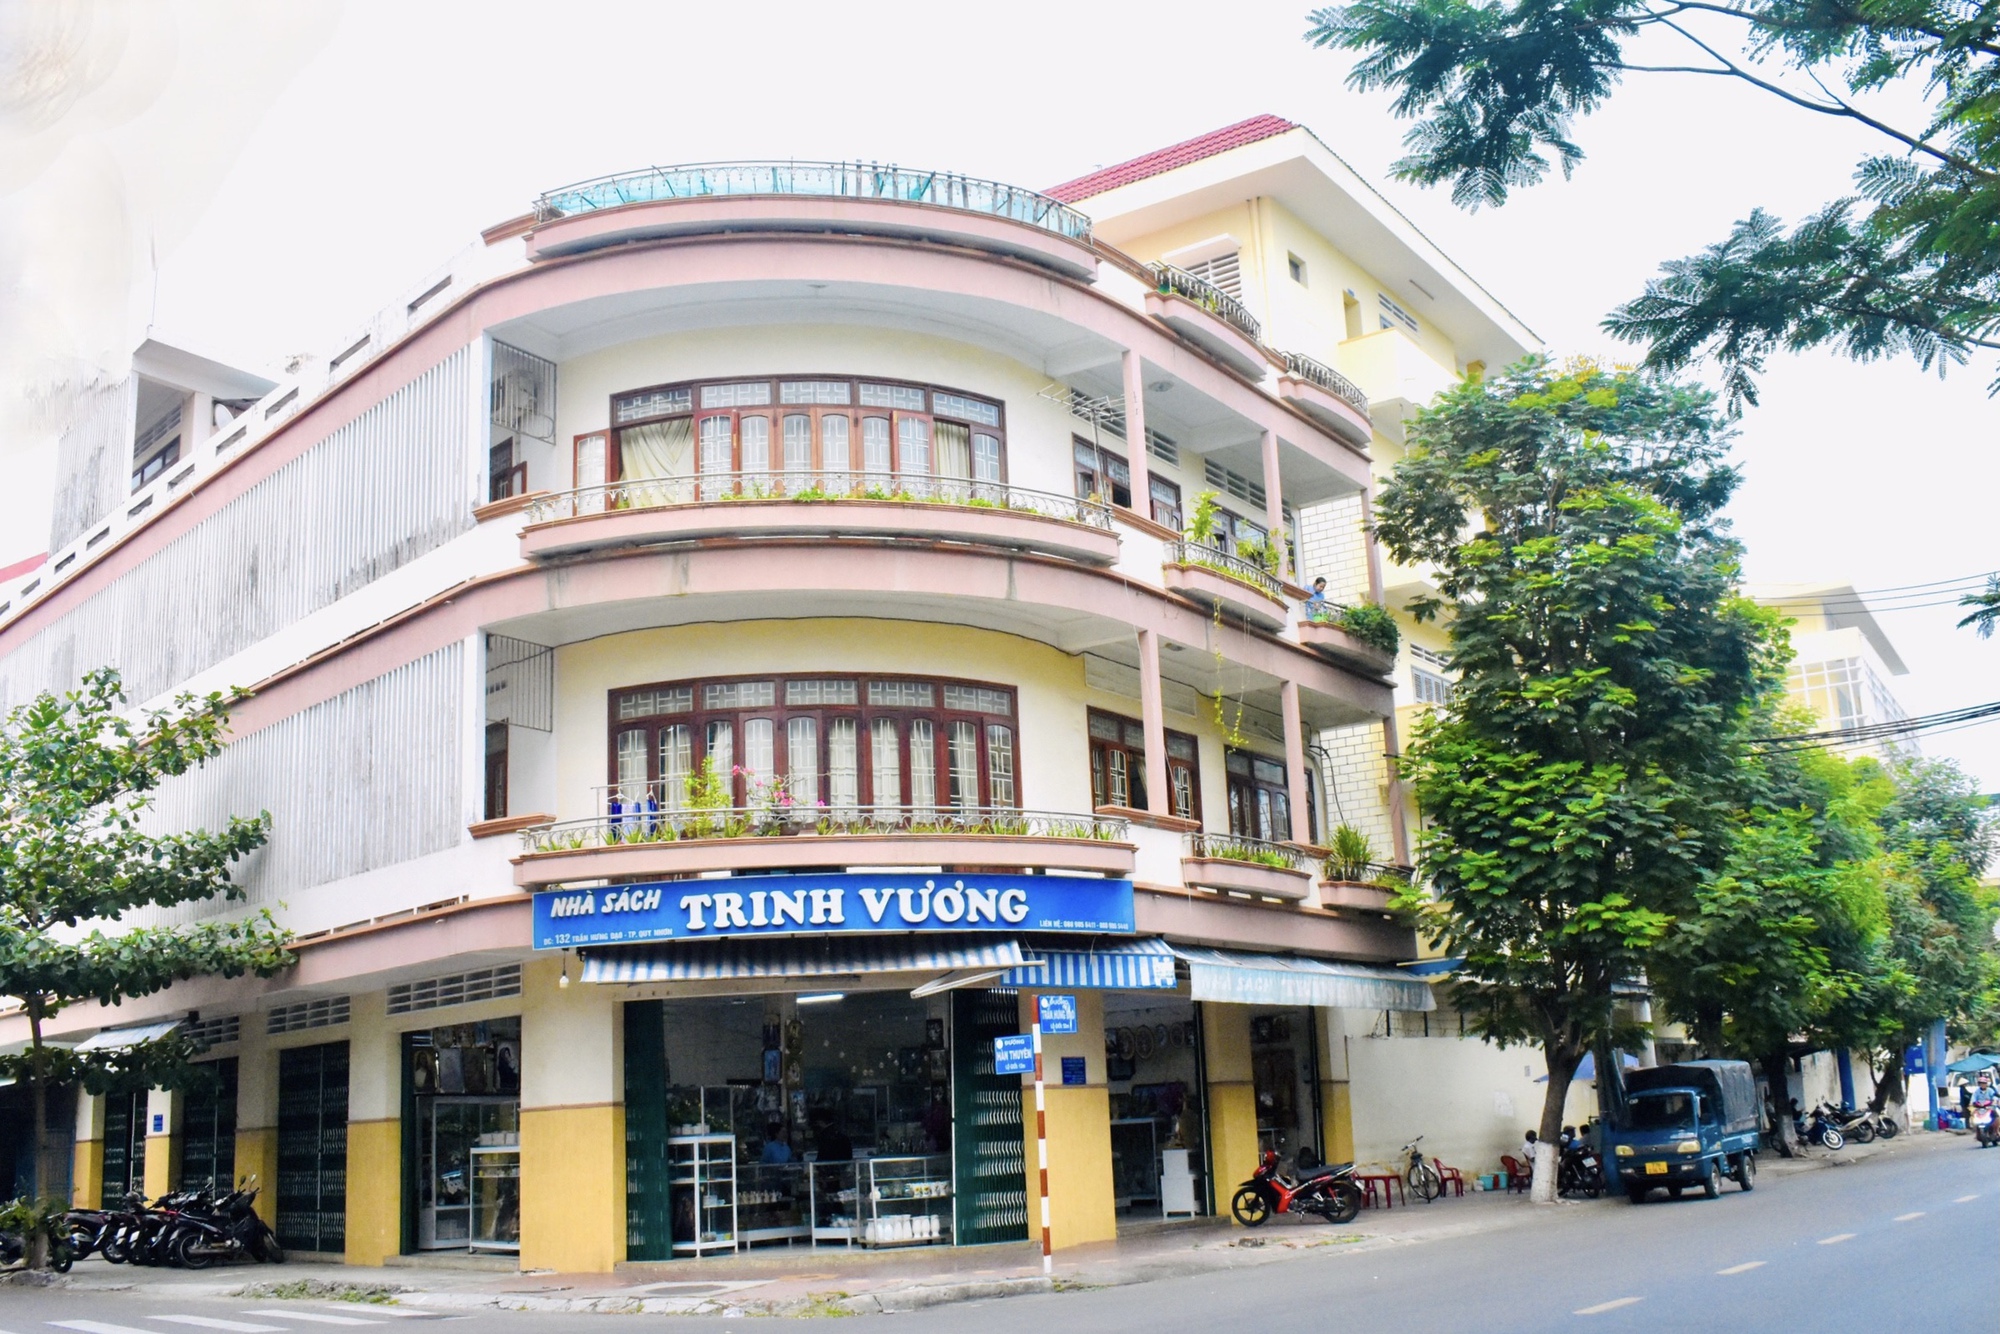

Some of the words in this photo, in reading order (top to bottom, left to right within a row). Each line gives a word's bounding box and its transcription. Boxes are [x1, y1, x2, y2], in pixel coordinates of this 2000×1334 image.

[550, 889, 596, 918] NHÀ
[601, 886, 662, 914] SÁCH
[680, 889, 846, 931] TRINH
[858, 880, 1030, 924] VƯƠNG
[555, 933, 571, 944] 132
[638, 929, 652, 938] QUY
